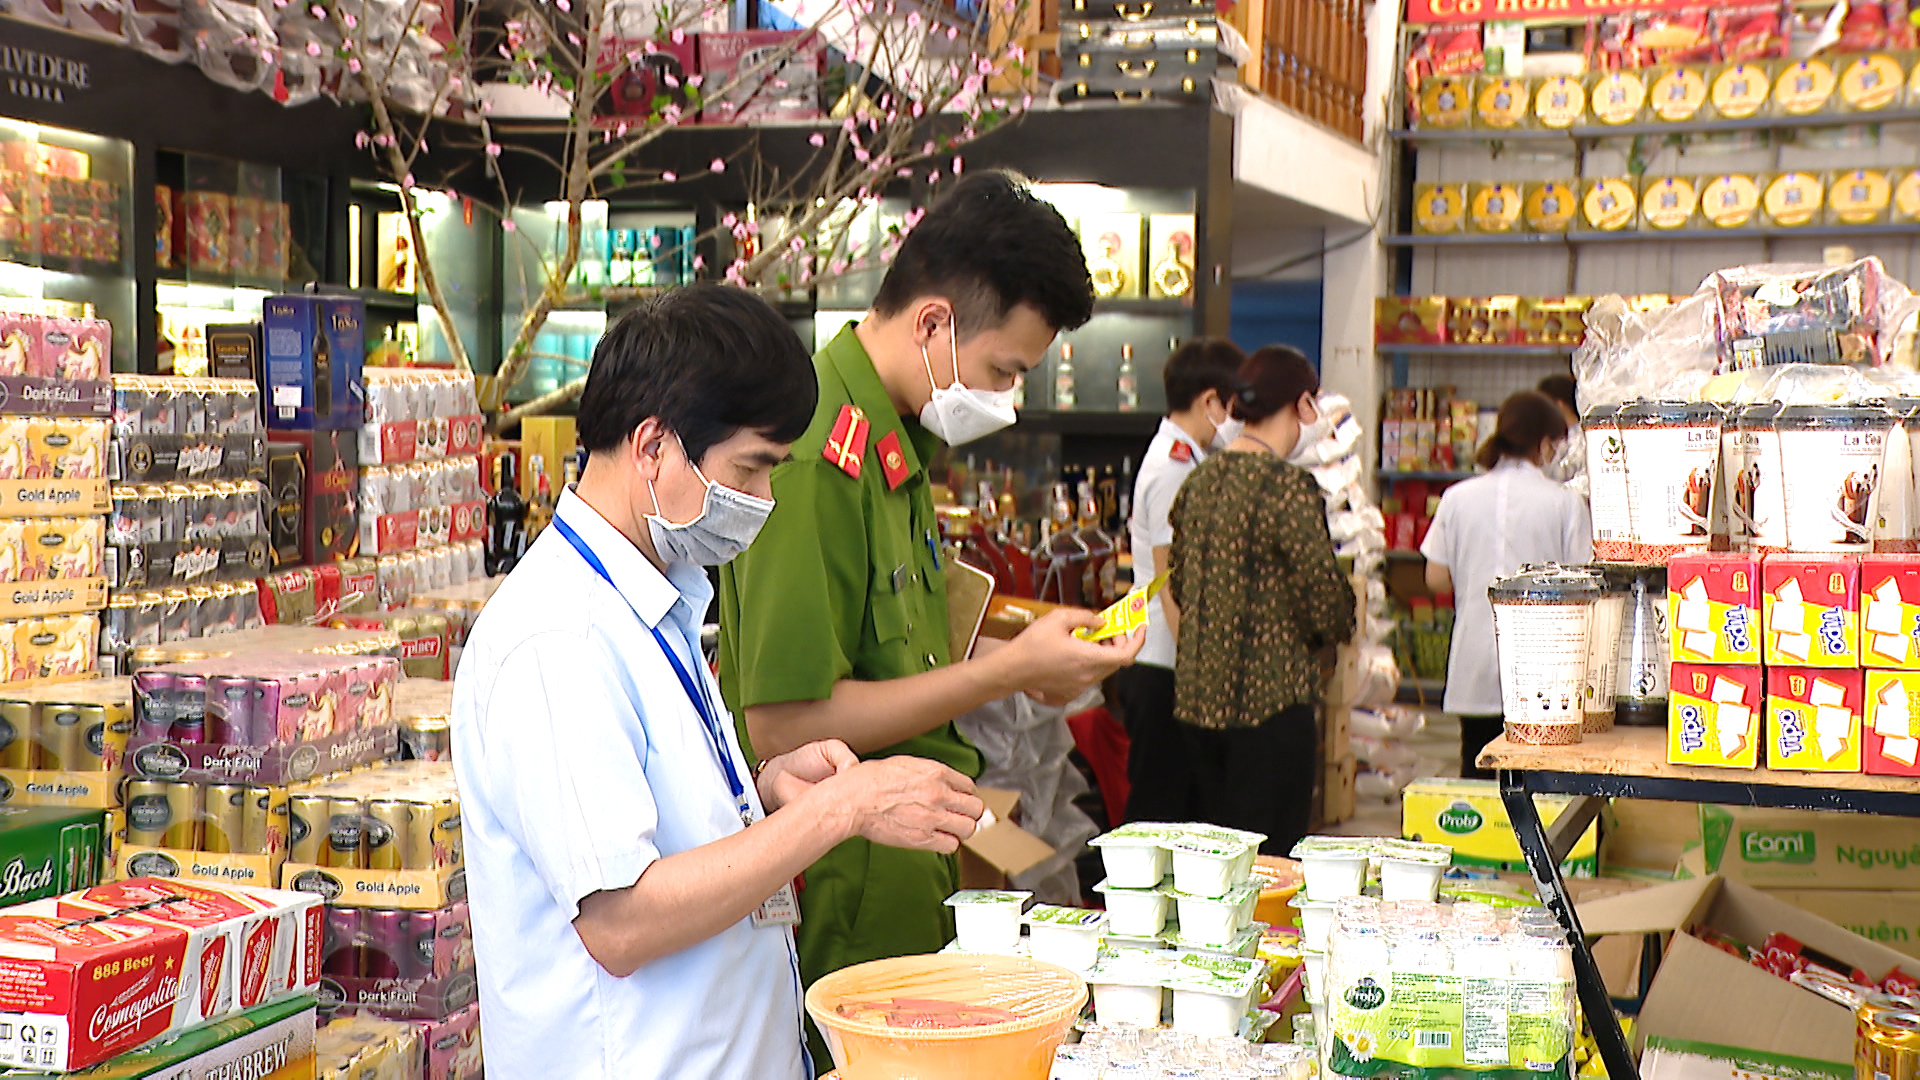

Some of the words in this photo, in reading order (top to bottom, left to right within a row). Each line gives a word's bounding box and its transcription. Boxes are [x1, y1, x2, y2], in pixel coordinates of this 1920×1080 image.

[23, 385, 51, 401] Dark
[17, 488, 46, 502] Gold
[48, 486, 81, 504] Apple
[12, 590, 40, 605] Gold
[42, 587, 74, 602] Apple
[1724, 603, 1749, 652] Tipo
[1819, 605, 1846, 655] Tipo
[1681, 705, 1706, 752] Tipo
[1779, 709, 1805, 758] Tipo
[203, 755, 233, 771] Dark
[234, 755, 262, 770] Fruit
[26, 782, 54, 795] Gold
[56, 783, 89, 797] Apple
[192, 864, 219, 877] Gold
[221, 866, 255, 880] Apple
[355, 881, 384, 894] Gold
[387, 882, 421, 896] Apple
[93, 961, 120, 980] 888
[123, 954, 156, 973] Beer
[358, 989, 388, 1003] Dark
[389, 988, 417, 1003] Fruit
[88, 974, 191, 1043] Cosmopolitan
